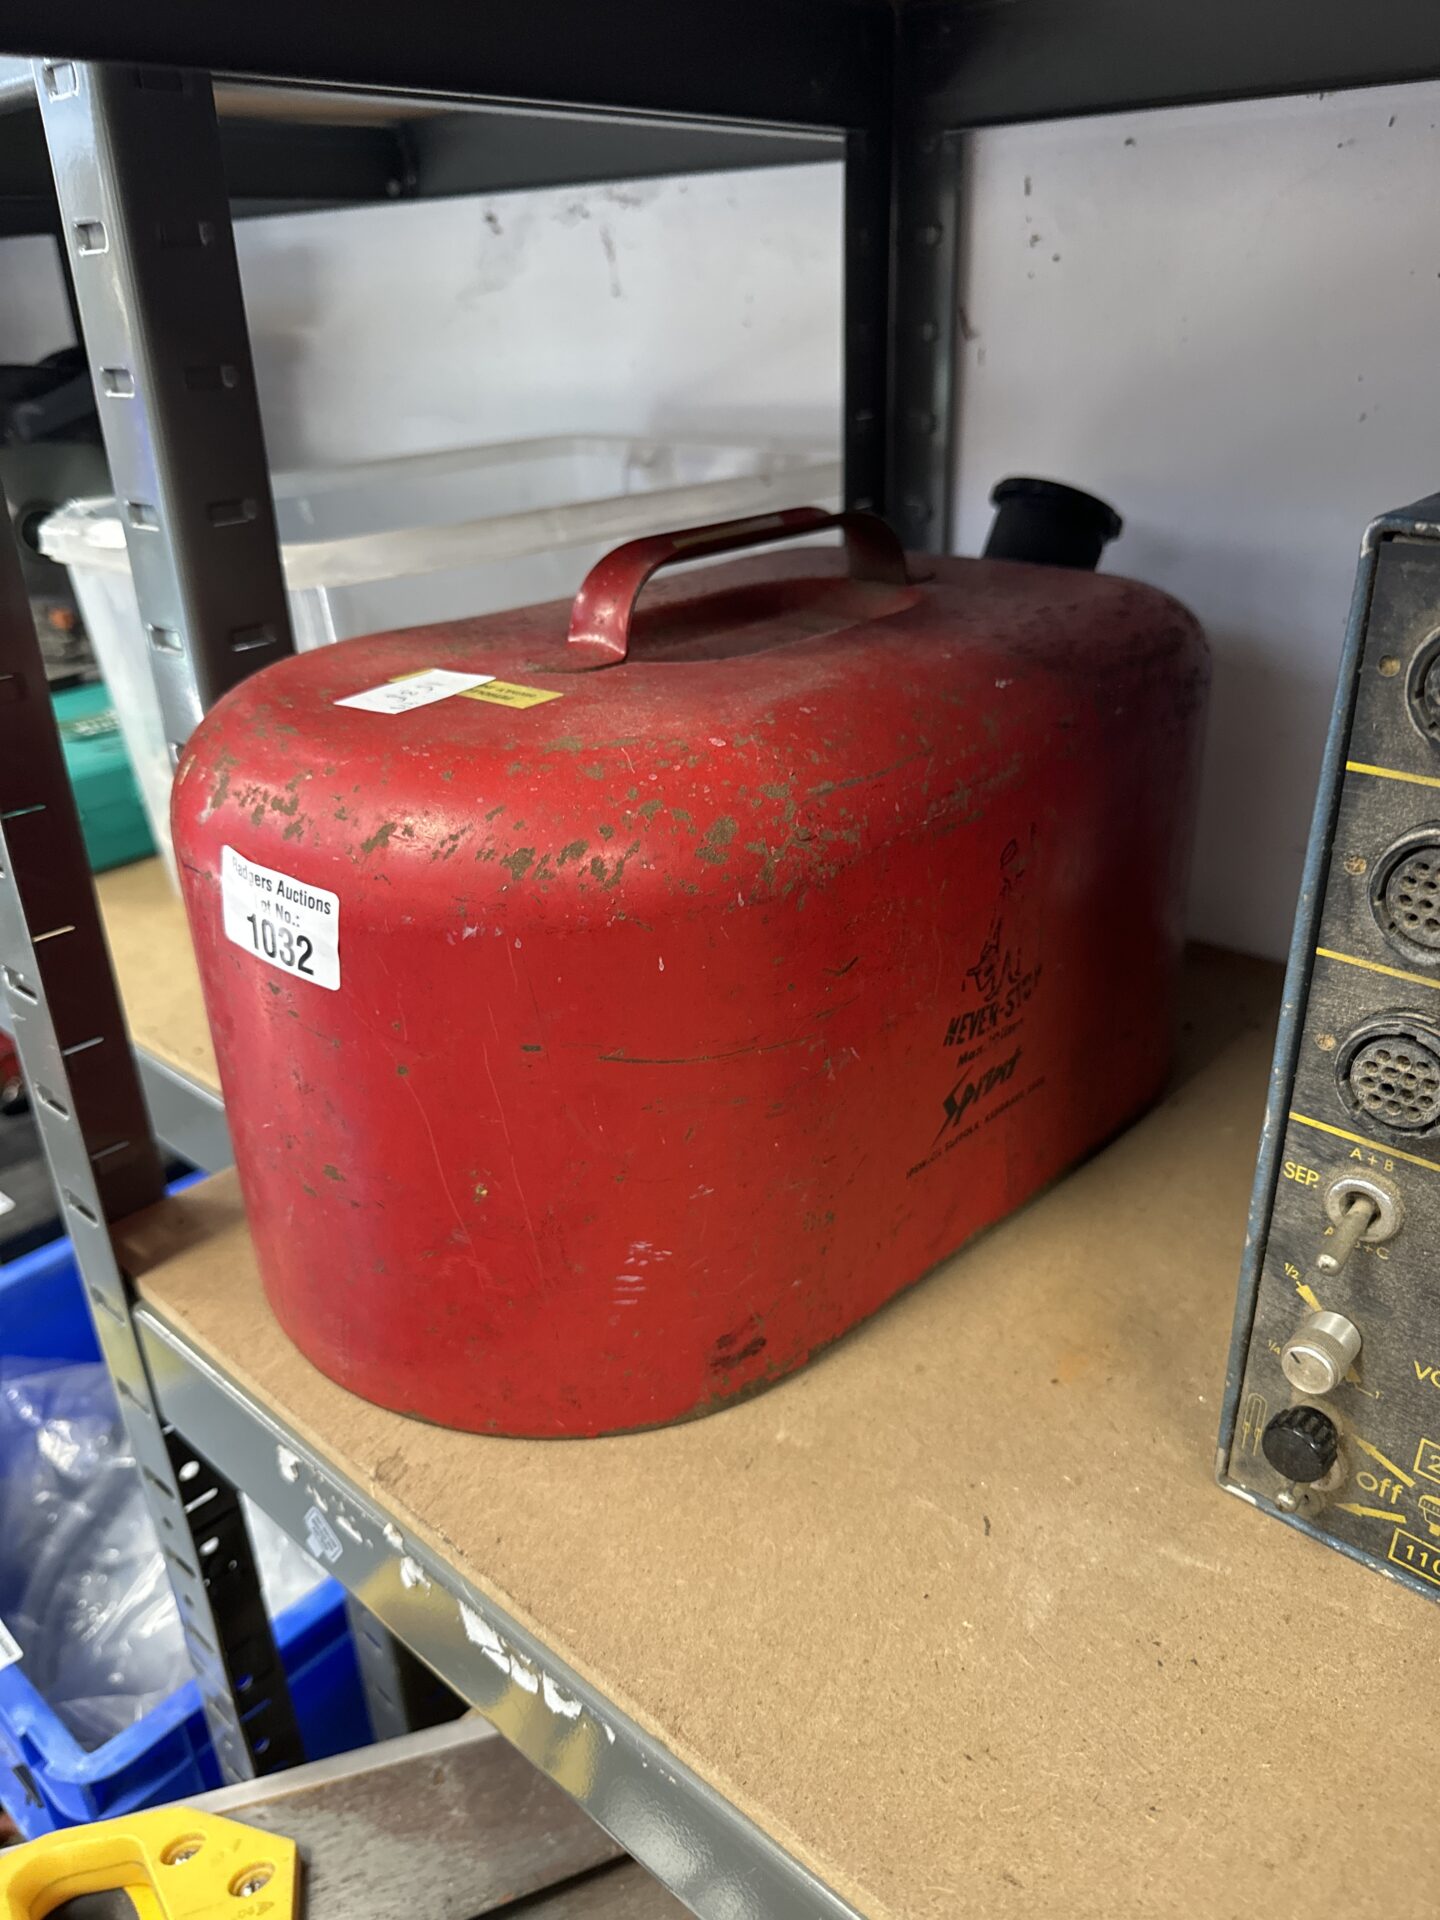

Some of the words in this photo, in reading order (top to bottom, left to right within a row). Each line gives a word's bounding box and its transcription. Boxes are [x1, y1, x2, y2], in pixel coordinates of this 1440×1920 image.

[276, 880, 331, 915] Auctions
[246, 913, 314, 975] 1032
[1283, 1161, 1320, 1188] SEP.
[1349, 1147, 1362, 1161] A
[1384, 1160, 1394, 1172] B
[1284, 1262, 1300, 1280] 1/2
[1355, 1471, 1404, 1505] Off
